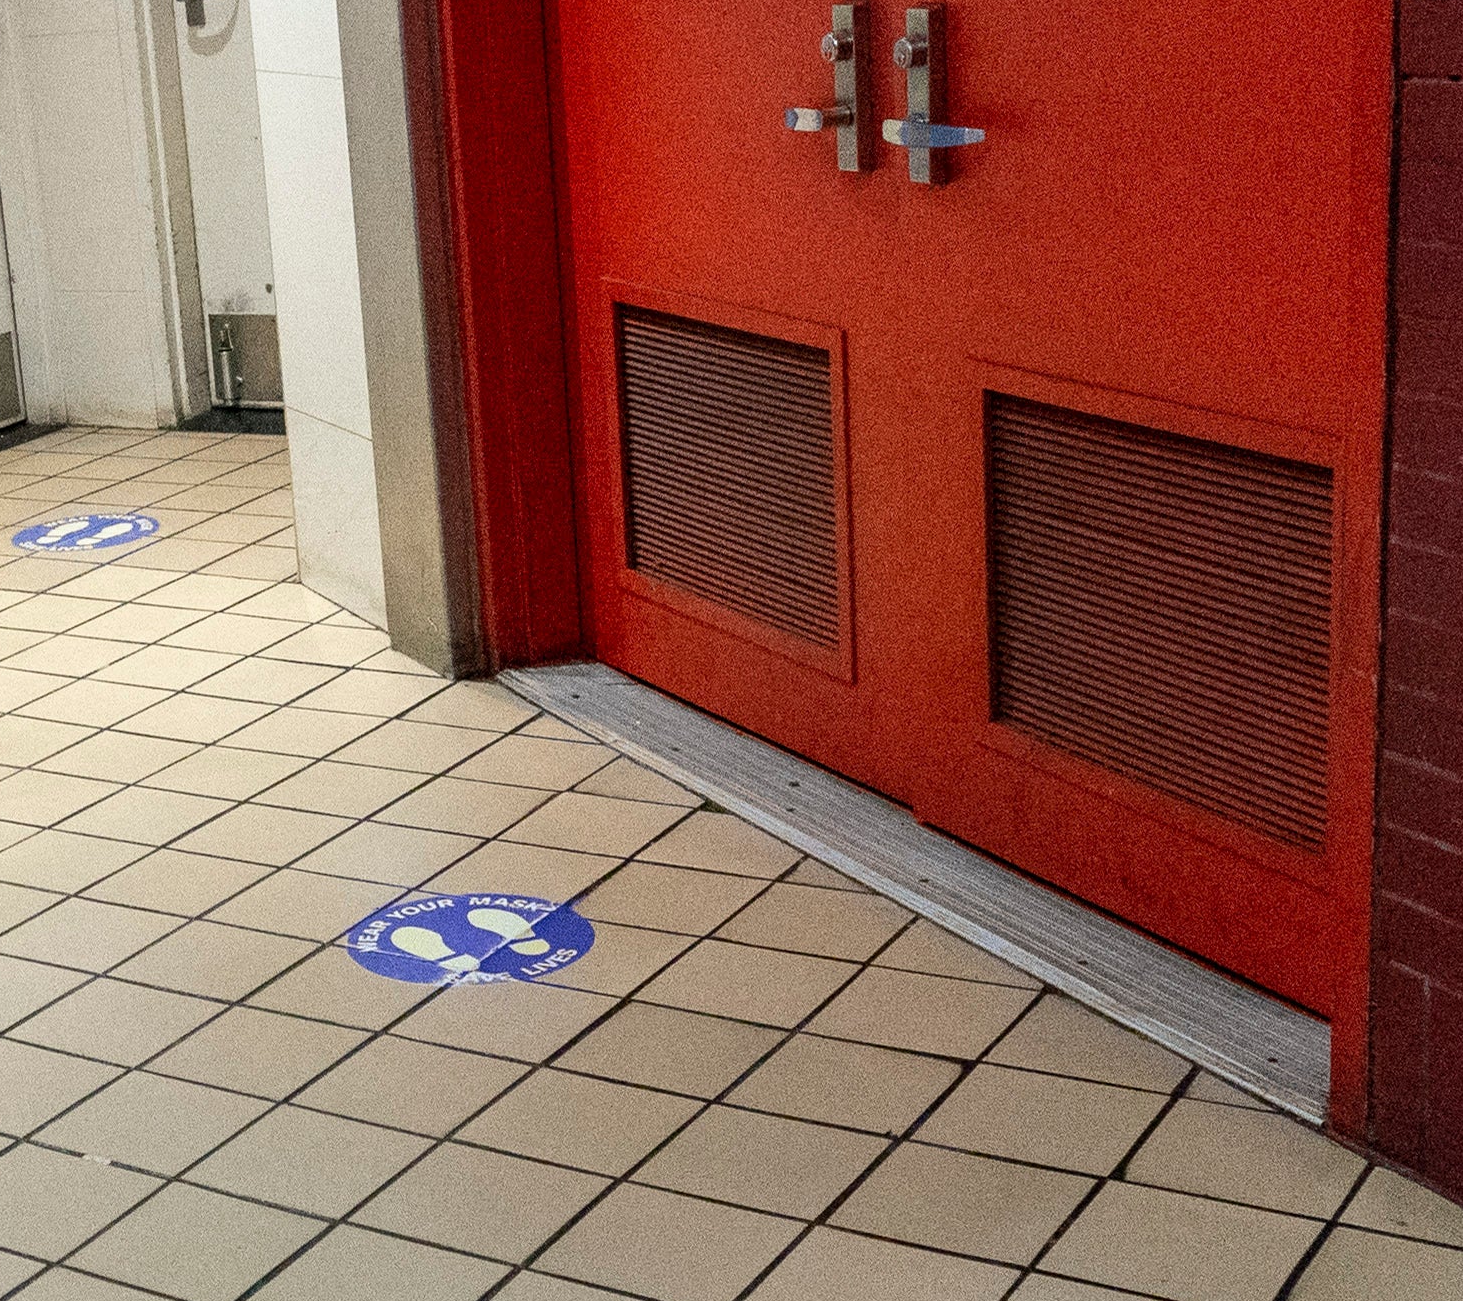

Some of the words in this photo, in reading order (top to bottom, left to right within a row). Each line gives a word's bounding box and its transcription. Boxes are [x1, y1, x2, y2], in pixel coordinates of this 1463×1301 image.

[356, 919, 392, 953] WEAR
[385, 898, 455, 920] YOUR
[469, 896, 546, 913] MASK
[521, 948, 578, 976] LIVES
